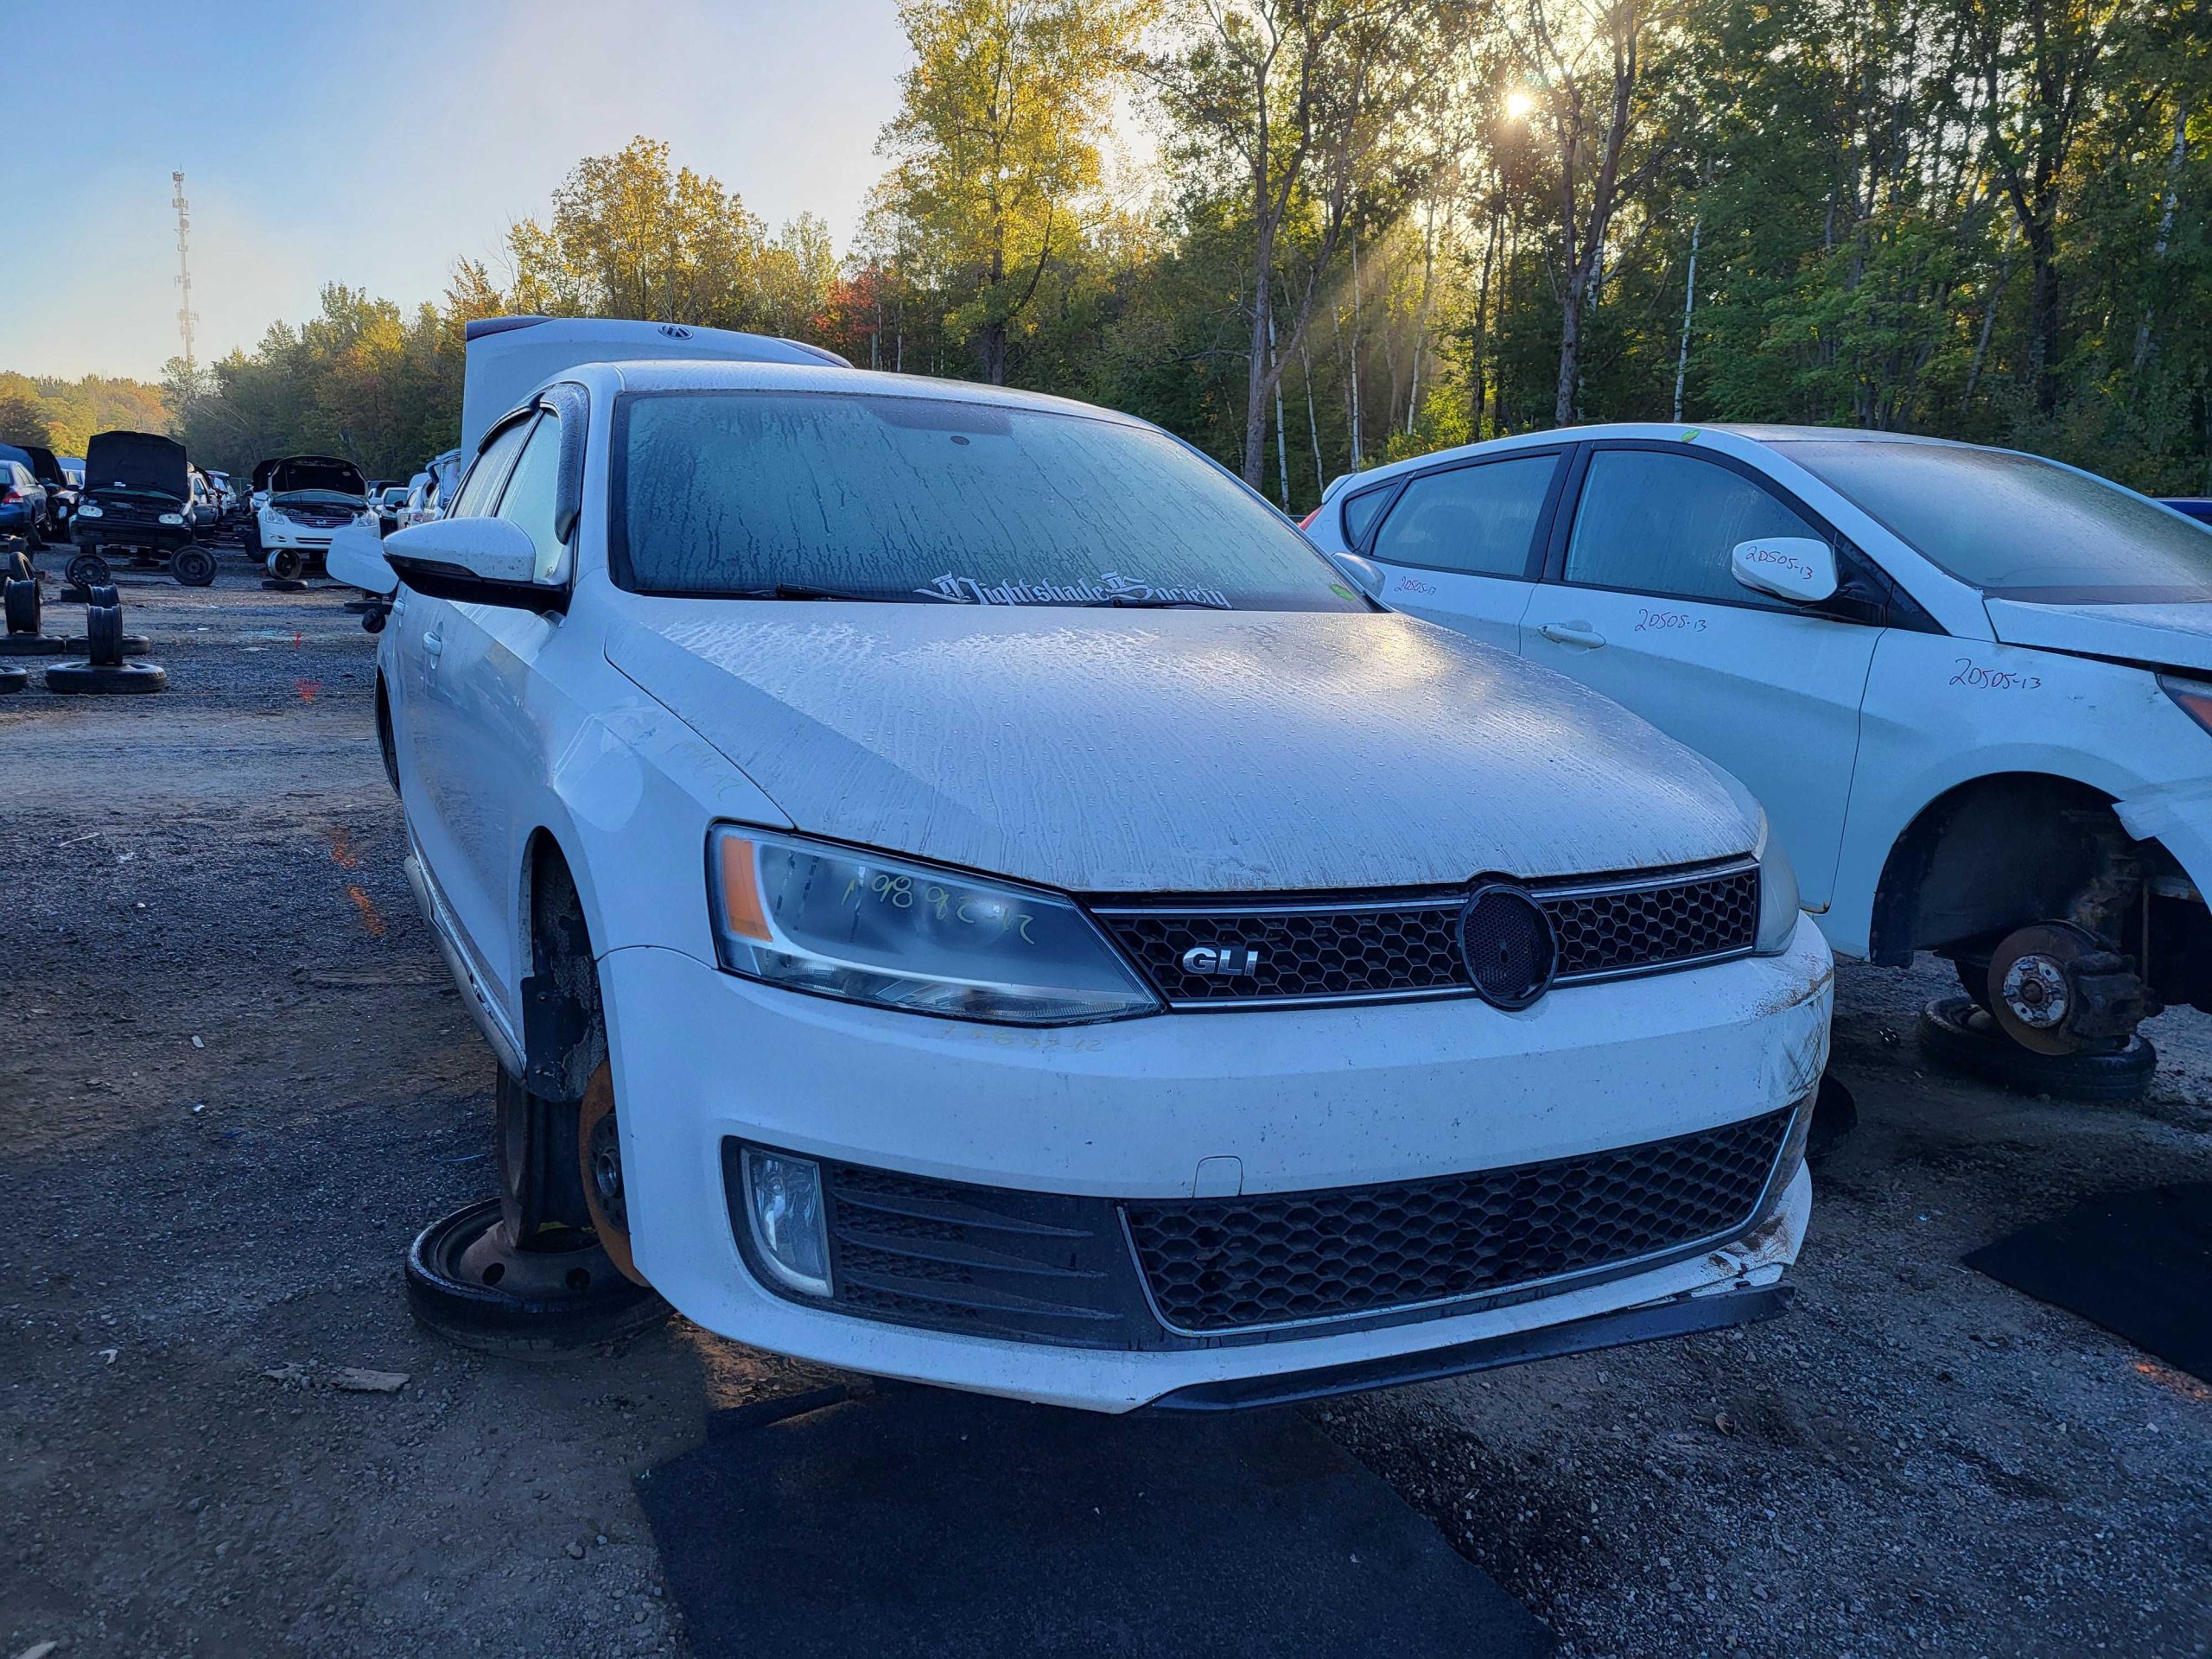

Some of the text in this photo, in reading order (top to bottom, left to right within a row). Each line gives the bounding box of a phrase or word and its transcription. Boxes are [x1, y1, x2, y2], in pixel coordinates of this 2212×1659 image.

[912, 570, 1233, 608] Nightshade Society
[1948, 658, 2042, 690] 20505-13
[1182, 947, 1259, 976] GLI
